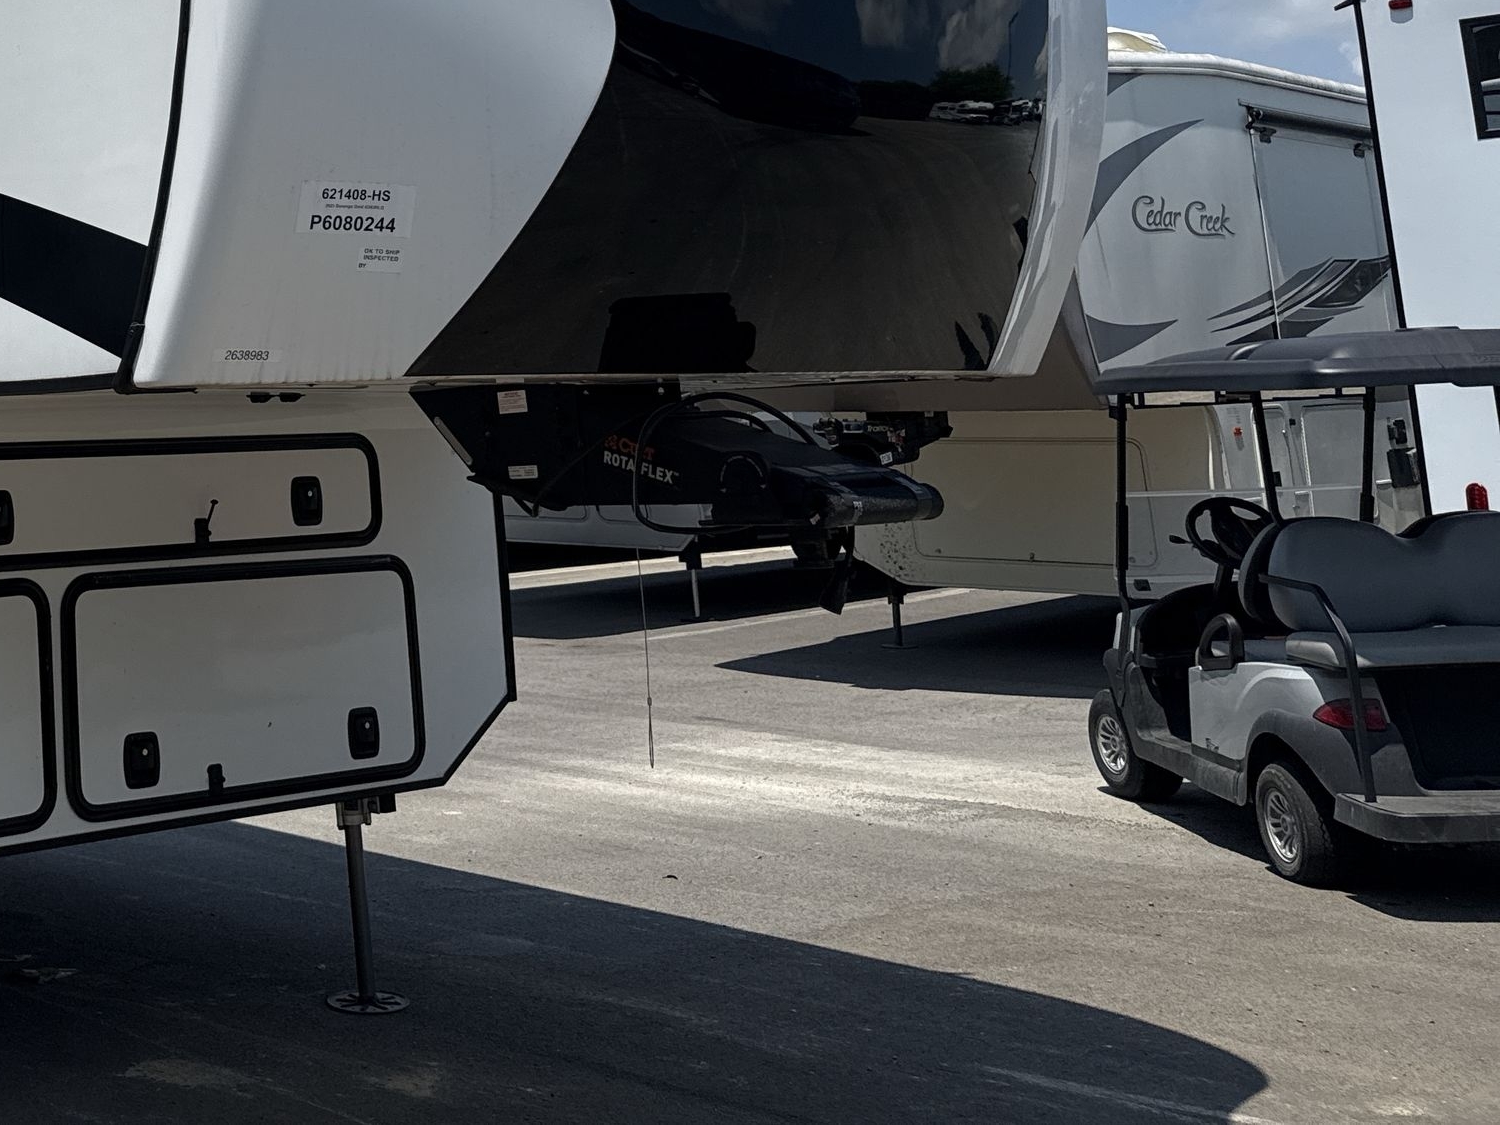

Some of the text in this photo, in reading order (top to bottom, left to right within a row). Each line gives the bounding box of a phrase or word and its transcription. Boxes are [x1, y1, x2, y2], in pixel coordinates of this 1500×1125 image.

[321, 188, 391, 202] 621408-HS
[309, 214, 396, 233] P6080244
[1132, 195, 1235, 238] Cedar Creek
[224, 349, 270, 361] 2638983
[603, 450, 636, 473] ROTA
